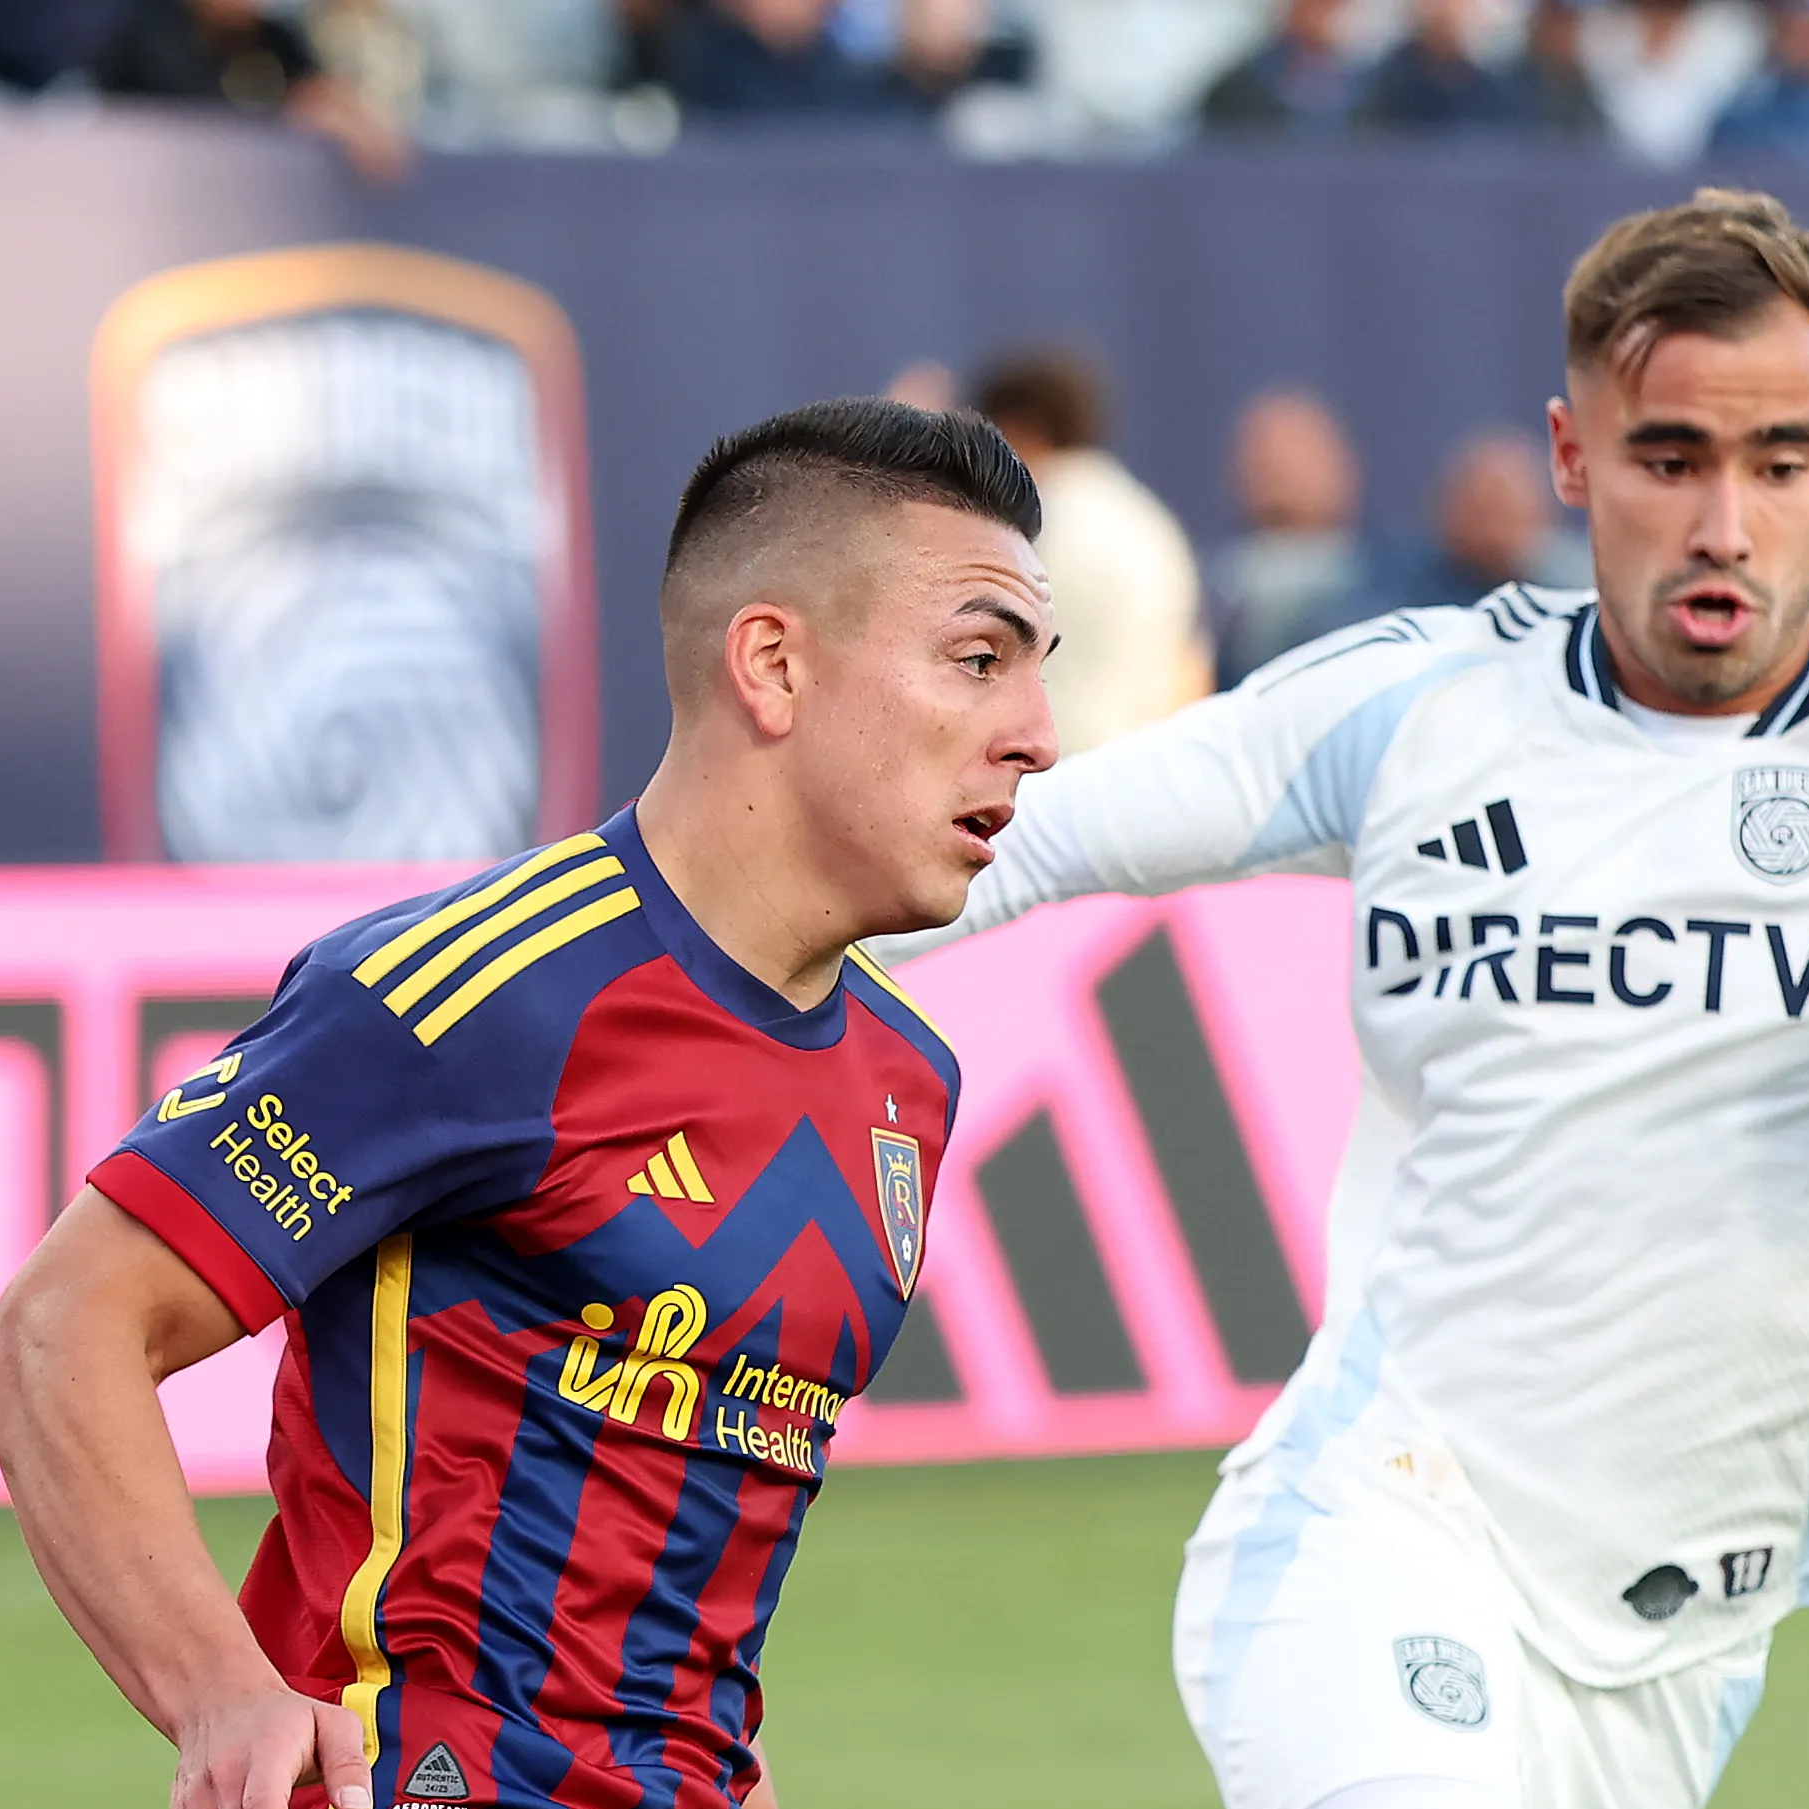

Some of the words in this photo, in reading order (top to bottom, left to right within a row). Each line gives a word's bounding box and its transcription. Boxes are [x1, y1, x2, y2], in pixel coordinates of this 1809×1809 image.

[209, 1121, 314, 1242] Health
[246, 1094, 354, 1215] Select
[722, 1354, 845, 1425] Intermo
[716, 1406, 816, 1474] Health
[416, 1773, 459, 1783] AUTHENTIC
[424, 1784, 448, 1793] 24/25
